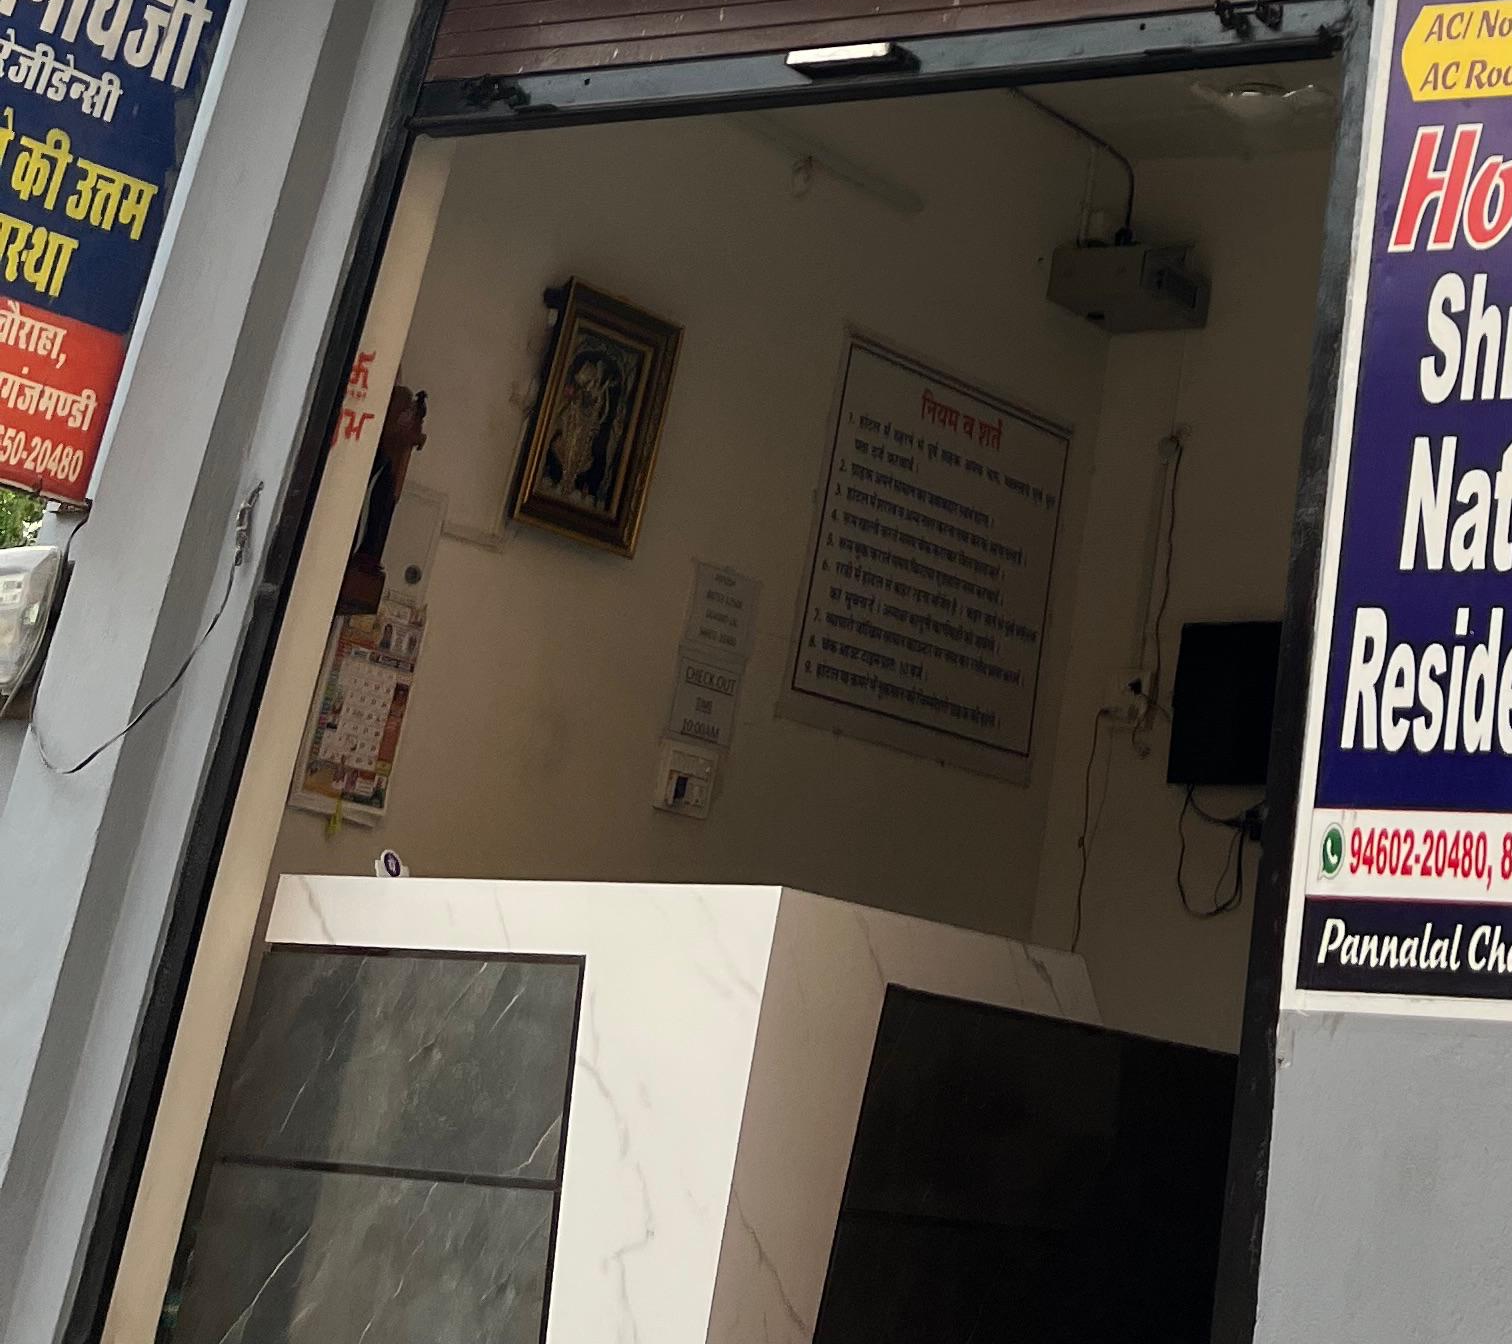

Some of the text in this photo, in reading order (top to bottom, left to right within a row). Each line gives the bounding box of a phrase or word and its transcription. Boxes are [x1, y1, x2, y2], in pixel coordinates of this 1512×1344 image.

[1424, 12, 1470, 42] AC/
[1420, 62, 1460, 92] AC
[11, 128, 73, 210] की
[66, 157, 159, 241] उत्तम
[1349, 827, 1493, 891] 94602-20480,
[1318, 918, 1463, 973] Pannalal
